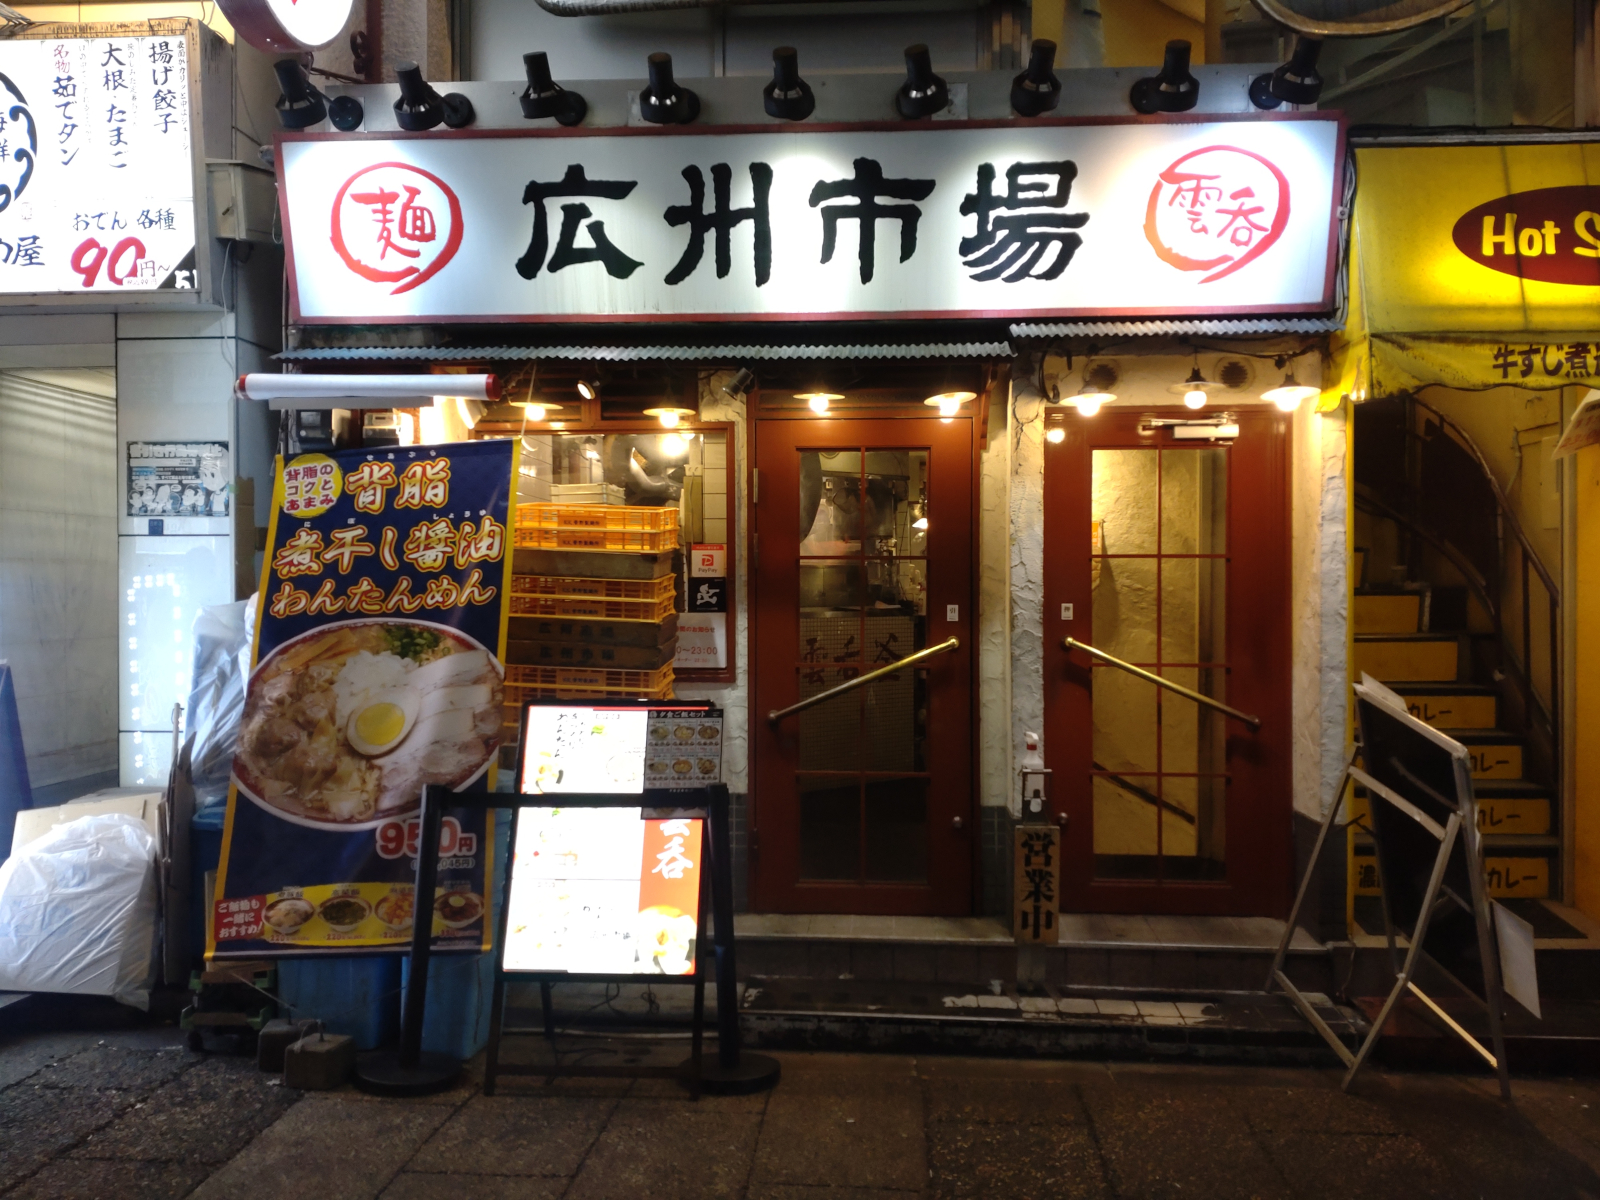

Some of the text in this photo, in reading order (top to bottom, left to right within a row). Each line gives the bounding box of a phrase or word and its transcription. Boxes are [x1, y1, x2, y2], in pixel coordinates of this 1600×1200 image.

[148, 40, 178, 134] 揚げ餃子
[73, 208, 176, 231] おでん 各種
[350, 185, 436, 260] 麺
[515, 156, 1090, 288] 広州市場
[1481, 212, 1561, 257] Hot
[284, 463, 334, 483] 背脂の
[286, 479, 334, 496] コクと
[345, 457, 451, 514] 背脂
[283, 496, 336, 513] あまみ
[273, 516, 506, 578] 煮干し醤油
[270, 569, 496, 618] わんたんめん
[1020, 832, 1056, 939] 営業中
[1488, 867, 1538, 888] カレー
